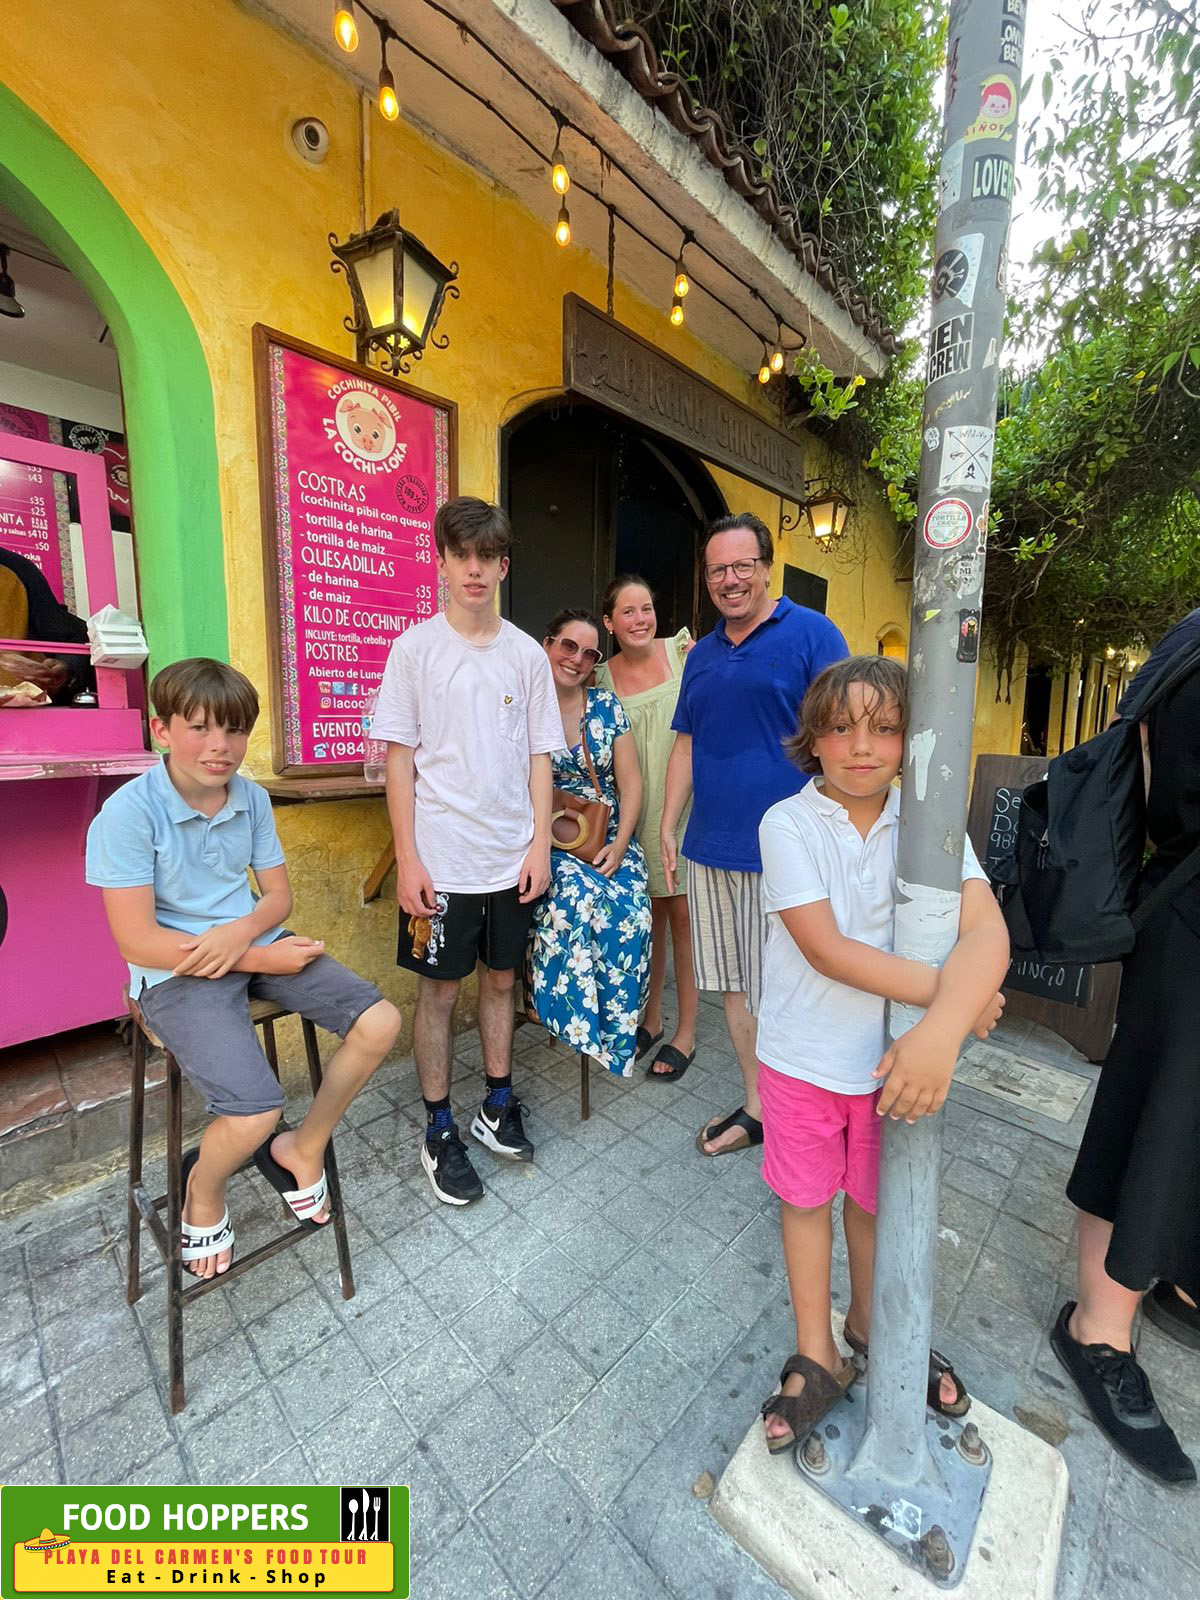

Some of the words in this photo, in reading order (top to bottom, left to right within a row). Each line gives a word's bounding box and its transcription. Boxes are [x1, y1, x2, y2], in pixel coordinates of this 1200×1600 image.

[930, 341, 971, 382] CREW
[328, 379, 379, 400] COCHINITA
[381, 394, 402, 422] PIBIL
[322, 417, 337, 440] LA
[334, 442, 407, 475] COCHI-LOKA
[297, 470, 366, 502] COSTRAS
[30, 496, 45, 506] $35
[31, 507, 46, 517] $25
[300, 491, 354, 513] (cochinita
[357, 506, 379, 518] pibil
[381, 512, 398, 523] con
[400, 517, 431, 531] queso)
[305, 512, 343, 530] tortilla
[346, 520, 359, 534] de
[361, 523, 393, 540] harina
[415, 534, 431, 548] $55
[306, 530, 344, 548] tortilla
[346, 538, 359, 550] de
[362, 543, 386, 555] maiz
[415, 550, 431, 564] $43
[301, 546, 395, 577] QUESADILLAS
[308, 570, 322, 583] de
[325, 571, 359, 589] harina
[415, 585, 431, 599] $35
[309, 588, 323, 601] de
[326, 590, 351, 605] maiz
[416, 601, 432, 614] $25
[304, 605, 332, 625] KILO
[336, 608, 350, 626] DE
[305, 630, 337, 642] INCLUYE:
[338, 632, 363, 645] tortilla,
[363, 634, 387, 646] cebolla
[387, 638, 391, 648] y
[305, 642, 359, 662] POSTRES
[309, 666, 345, 679] Abierto
[346, 668, 359, 679] de
[360, 669, 384, 680] Lune
[312, 722, 364, 738] EVENTO
[190, 1229, 230, 1248] FILA
